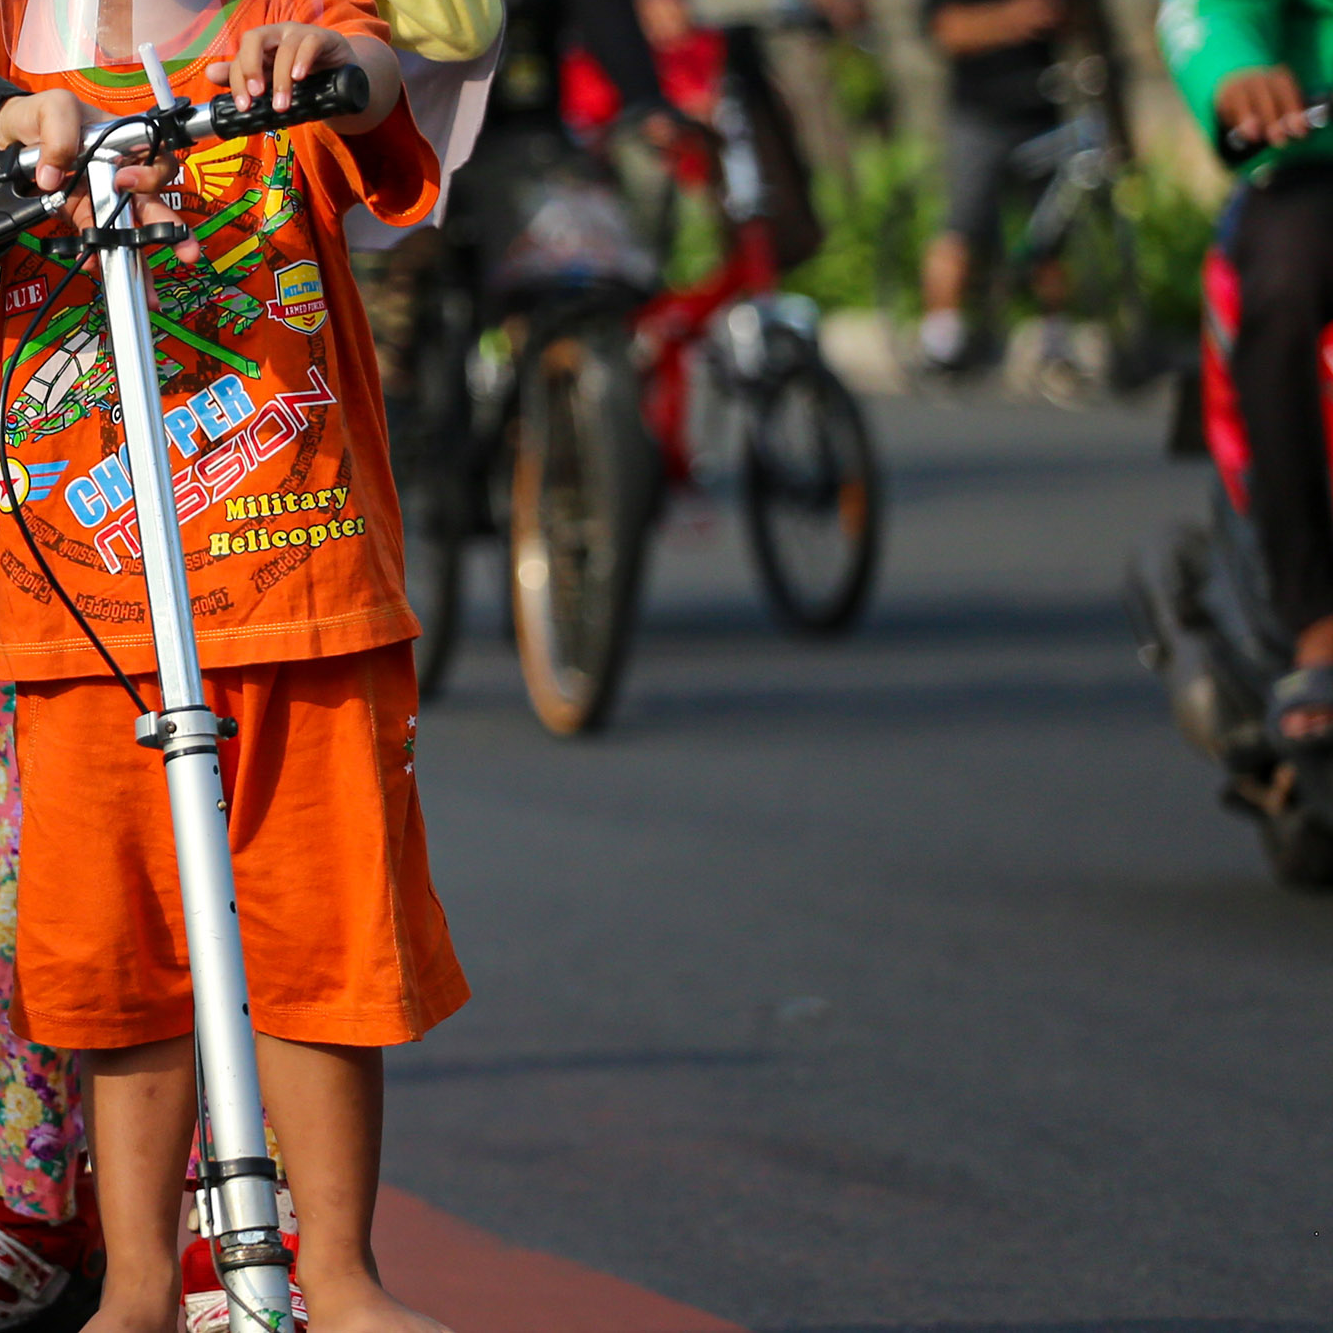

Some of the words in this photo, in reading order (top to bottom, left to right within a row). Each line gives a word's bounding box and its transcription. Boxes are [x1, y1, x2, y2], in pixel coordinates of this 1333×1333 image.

[5, 283, 43, 312] CUE
[285, 303, 307, 316] ARMED
[64, 373, 256, 528] CHPER
[93, 365, 337, 575] MSSION
[225, 486, 348, 522] Military
[209, 517, 365, 556] Helicopter
